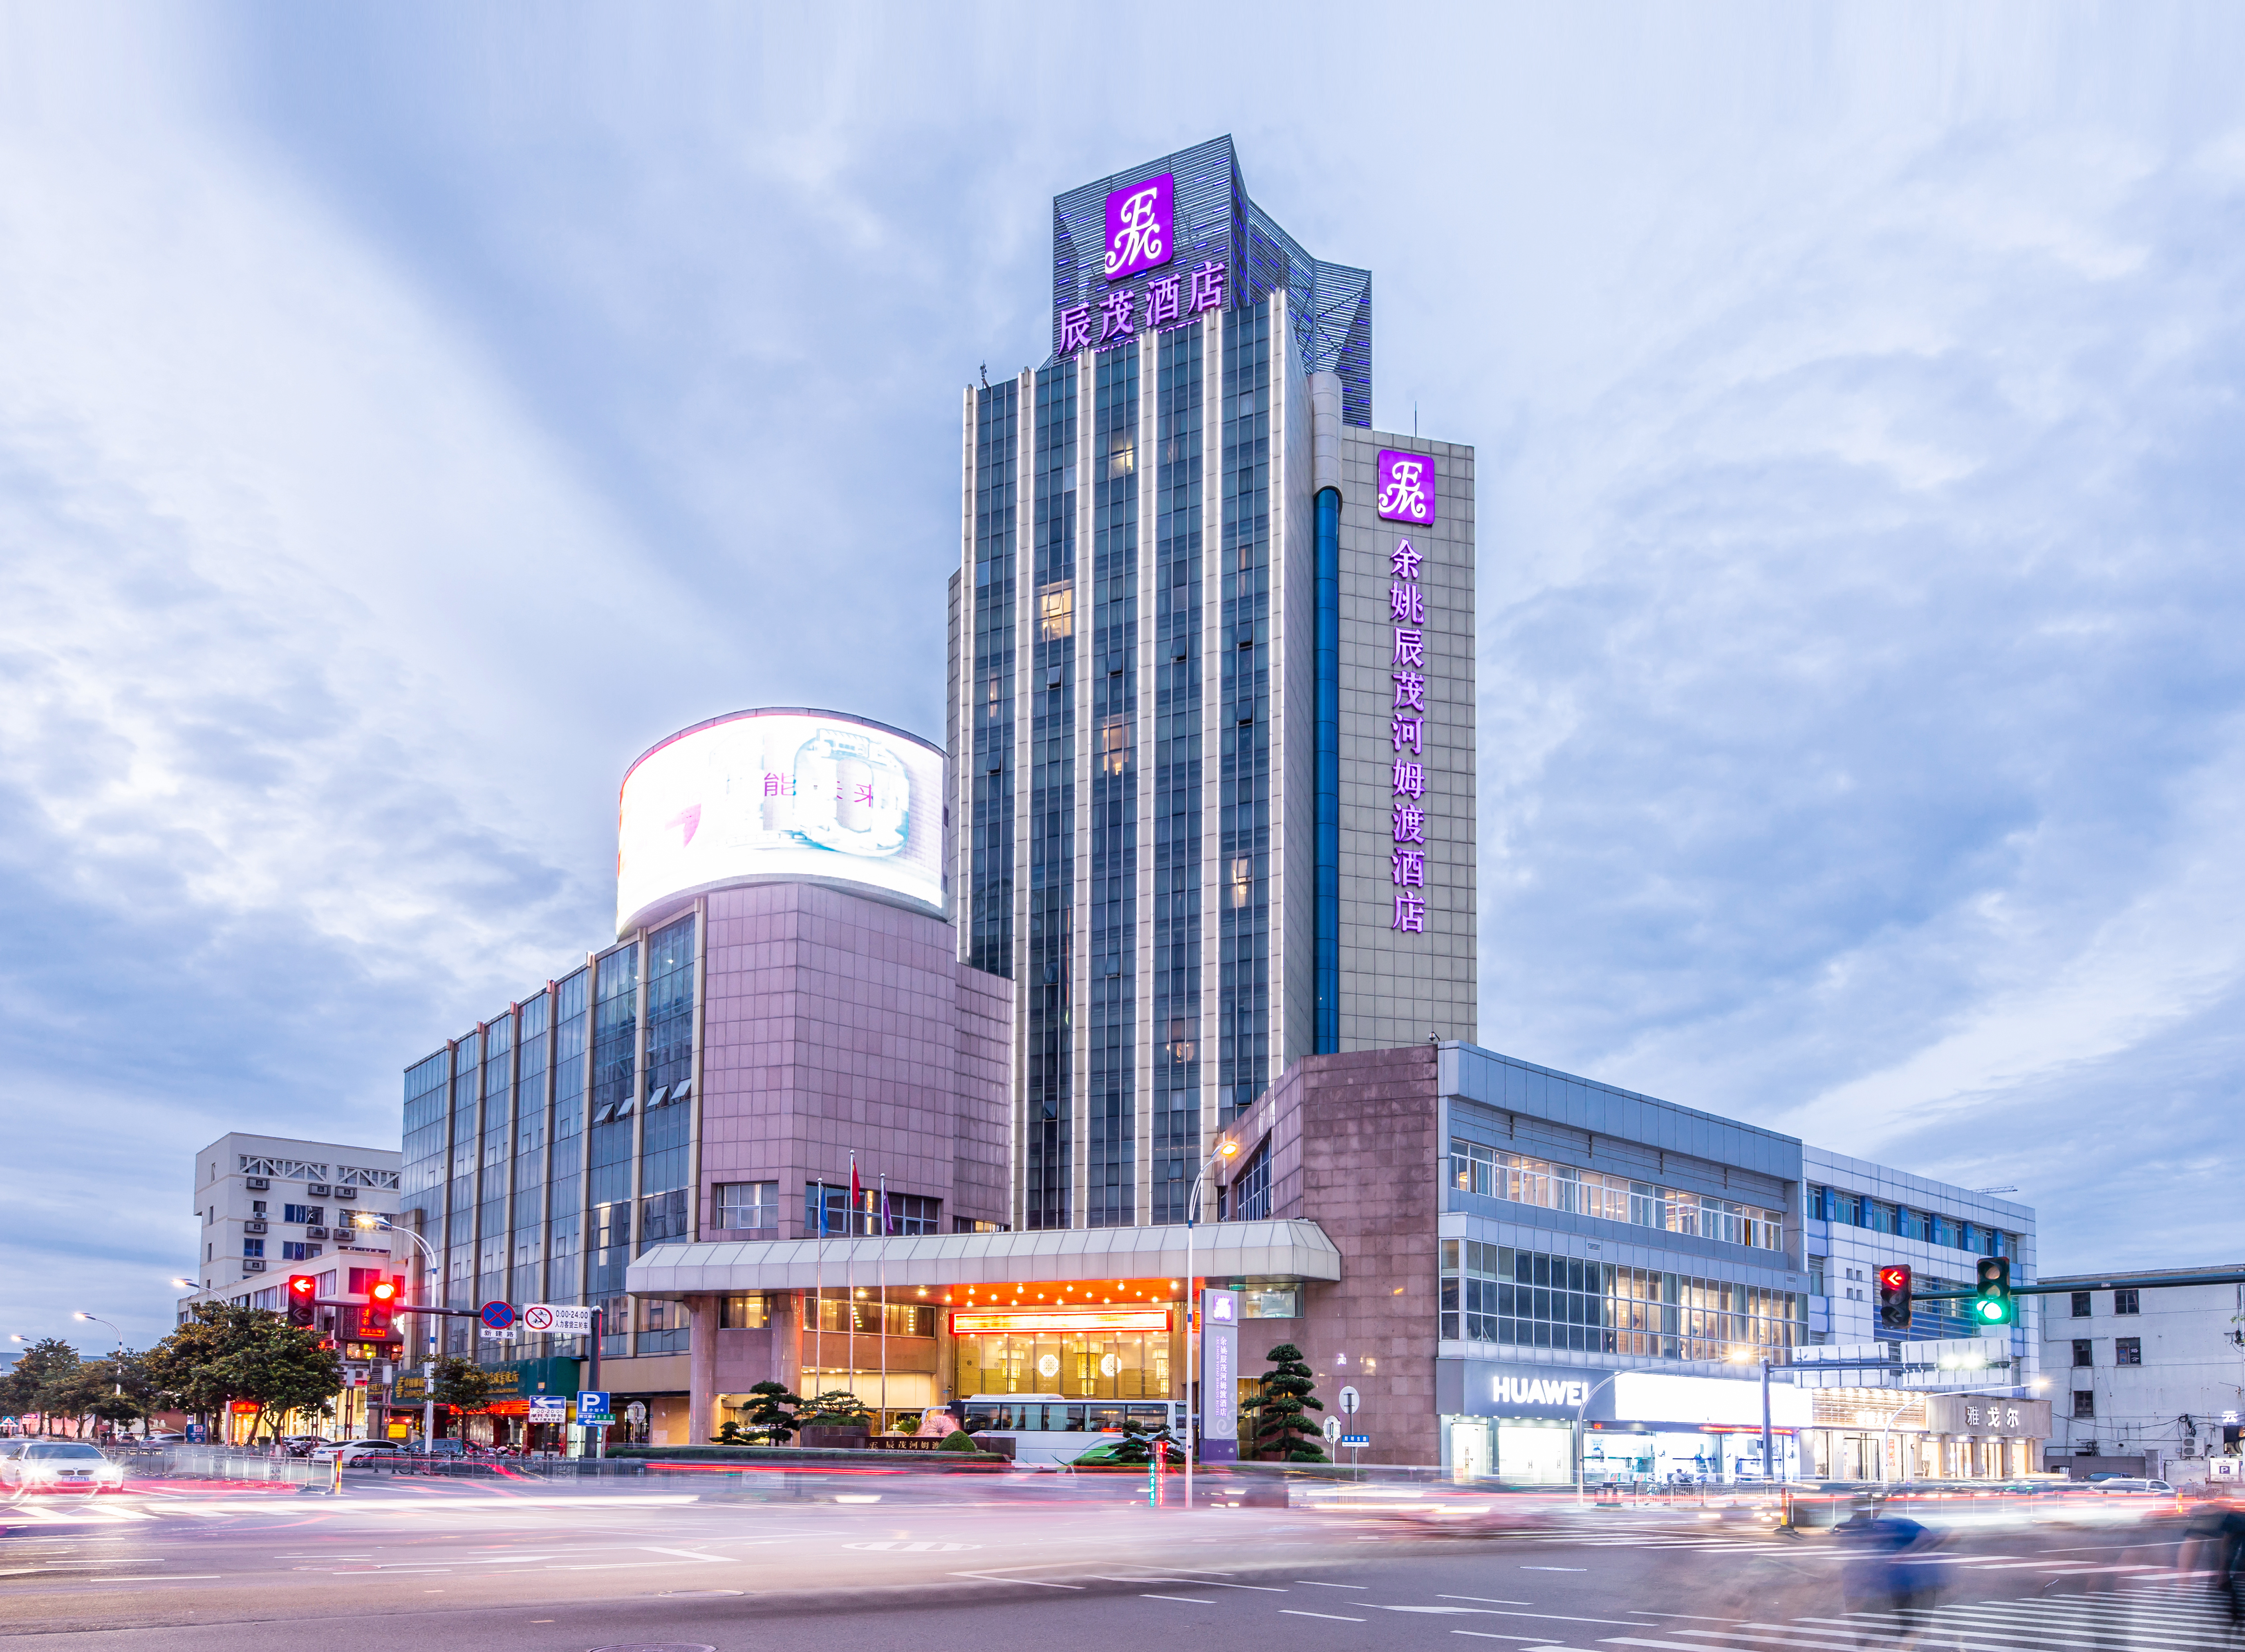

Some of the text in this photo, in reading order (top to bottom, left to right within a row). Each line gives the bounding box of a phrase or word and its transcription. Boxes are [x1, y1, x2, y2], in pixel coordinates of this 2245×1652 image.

[1058, 261, 1226, 356] 辰茂酒店
[1390, 538, 1425, 934] 余姚辰茂河姆渡酒店
[555, 1320, 588, 1329] 人力客货三轮车
[556, 1310, 588, 1319] 0:00-24:00
[1493, 1376, 1589, 1406] HUAWEI
[582, 1394, 600, 1412] P
[1967, 1406, 2019, 1428] 雅戈尔
[2222, 1411, 2238, 1423] 云
